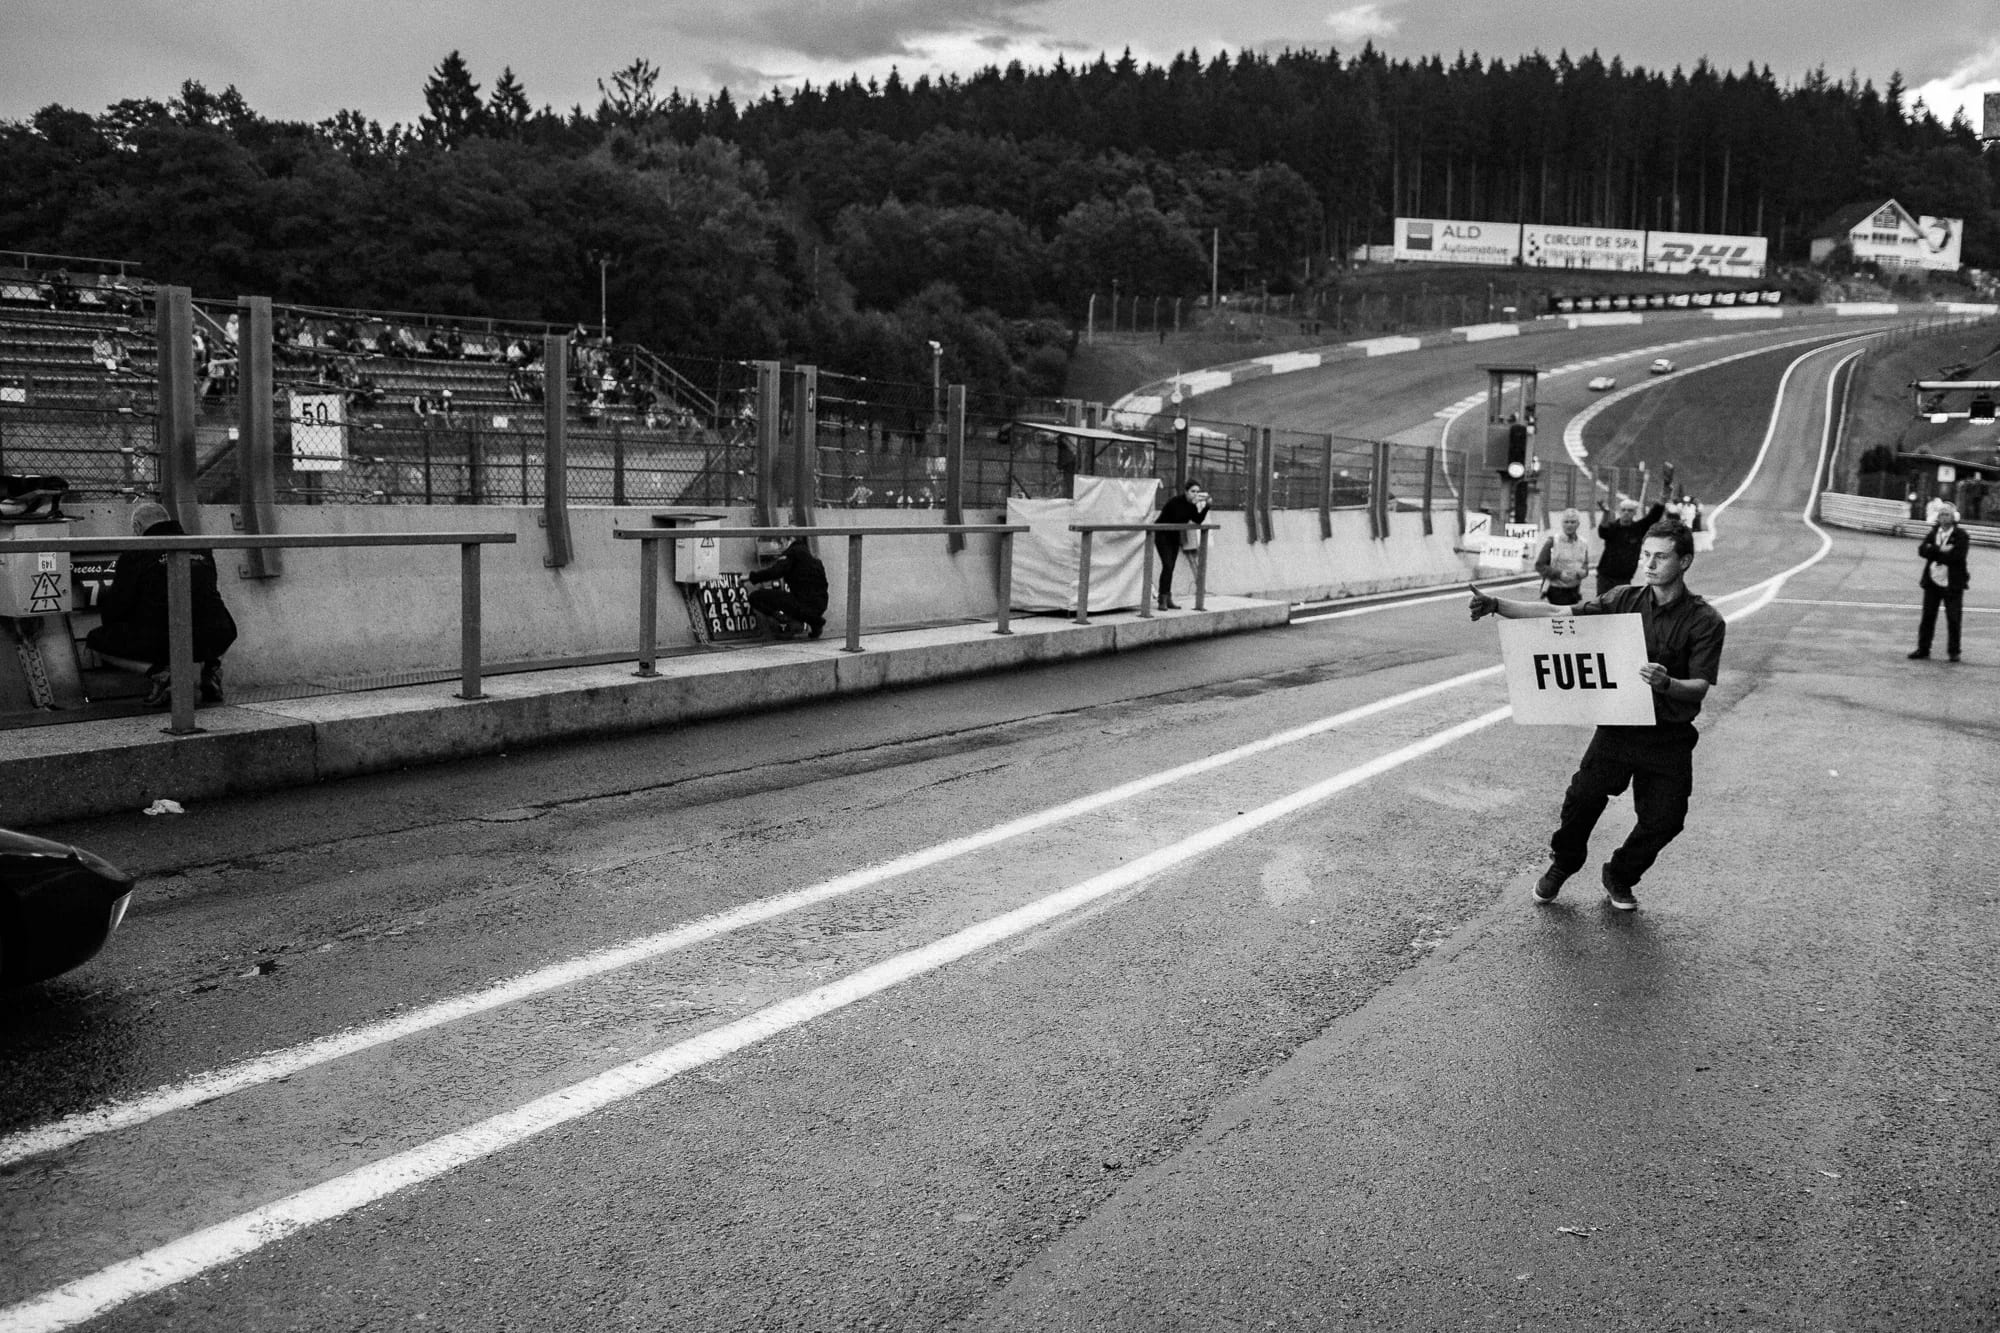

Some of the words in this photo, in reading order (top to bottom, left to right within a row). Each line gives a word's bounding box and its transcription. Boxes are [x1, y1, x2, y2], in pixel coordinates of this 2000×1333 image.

[1442, 224, 1482, 239] ALD
[1544, 233, 1591, 246] CIRCUIT
[1595, 236, 1612, 247] DE
[1615, 237, 1639, 248] SPA
[1658, 243, 1752, 265] DHL
[302, 402, 328, 426] 50
[1533, 653, 1618, 690] FUEL
